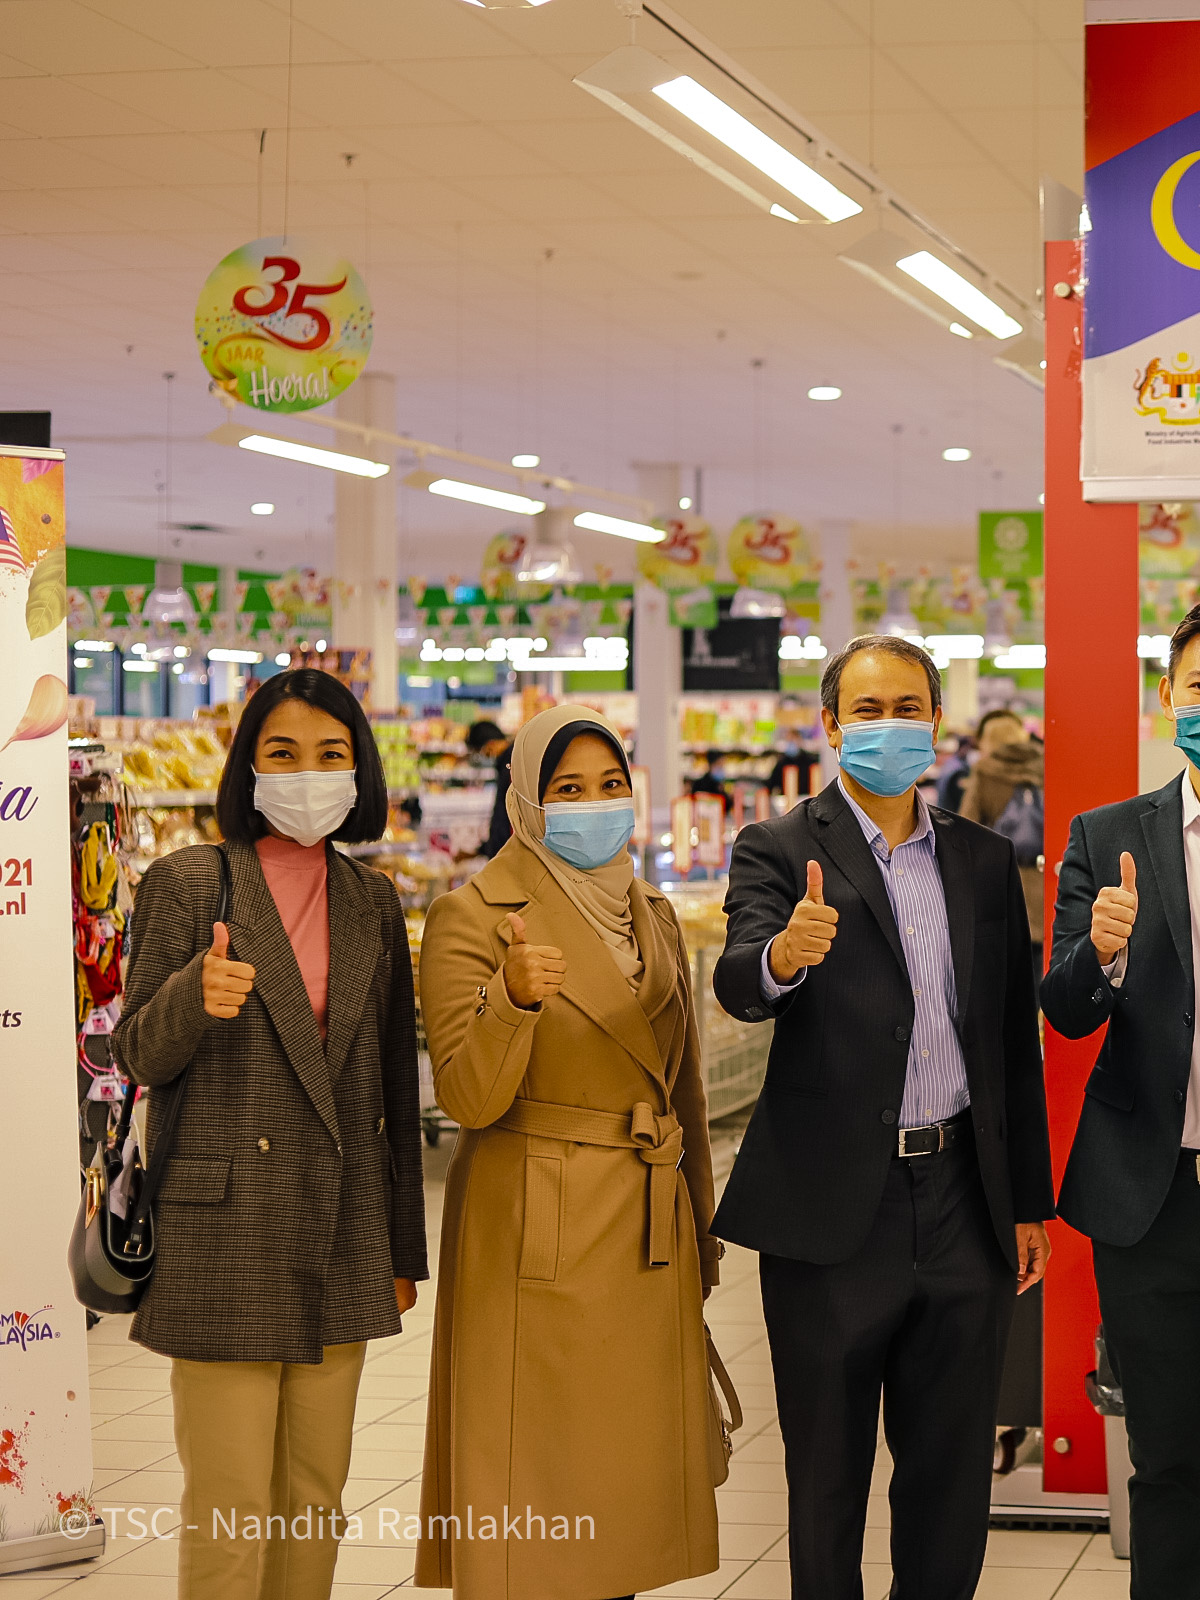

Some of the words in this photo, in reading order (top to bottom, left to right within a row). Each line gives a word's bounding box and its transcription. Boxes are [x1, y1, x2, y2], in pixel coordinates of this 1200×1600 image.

[233, 256, 347, 351] 35
[226, 344, 264, 363] JAAR
[249, 365, 329, 407] Hoera!
[0, 1009, 22, 1028] ts
